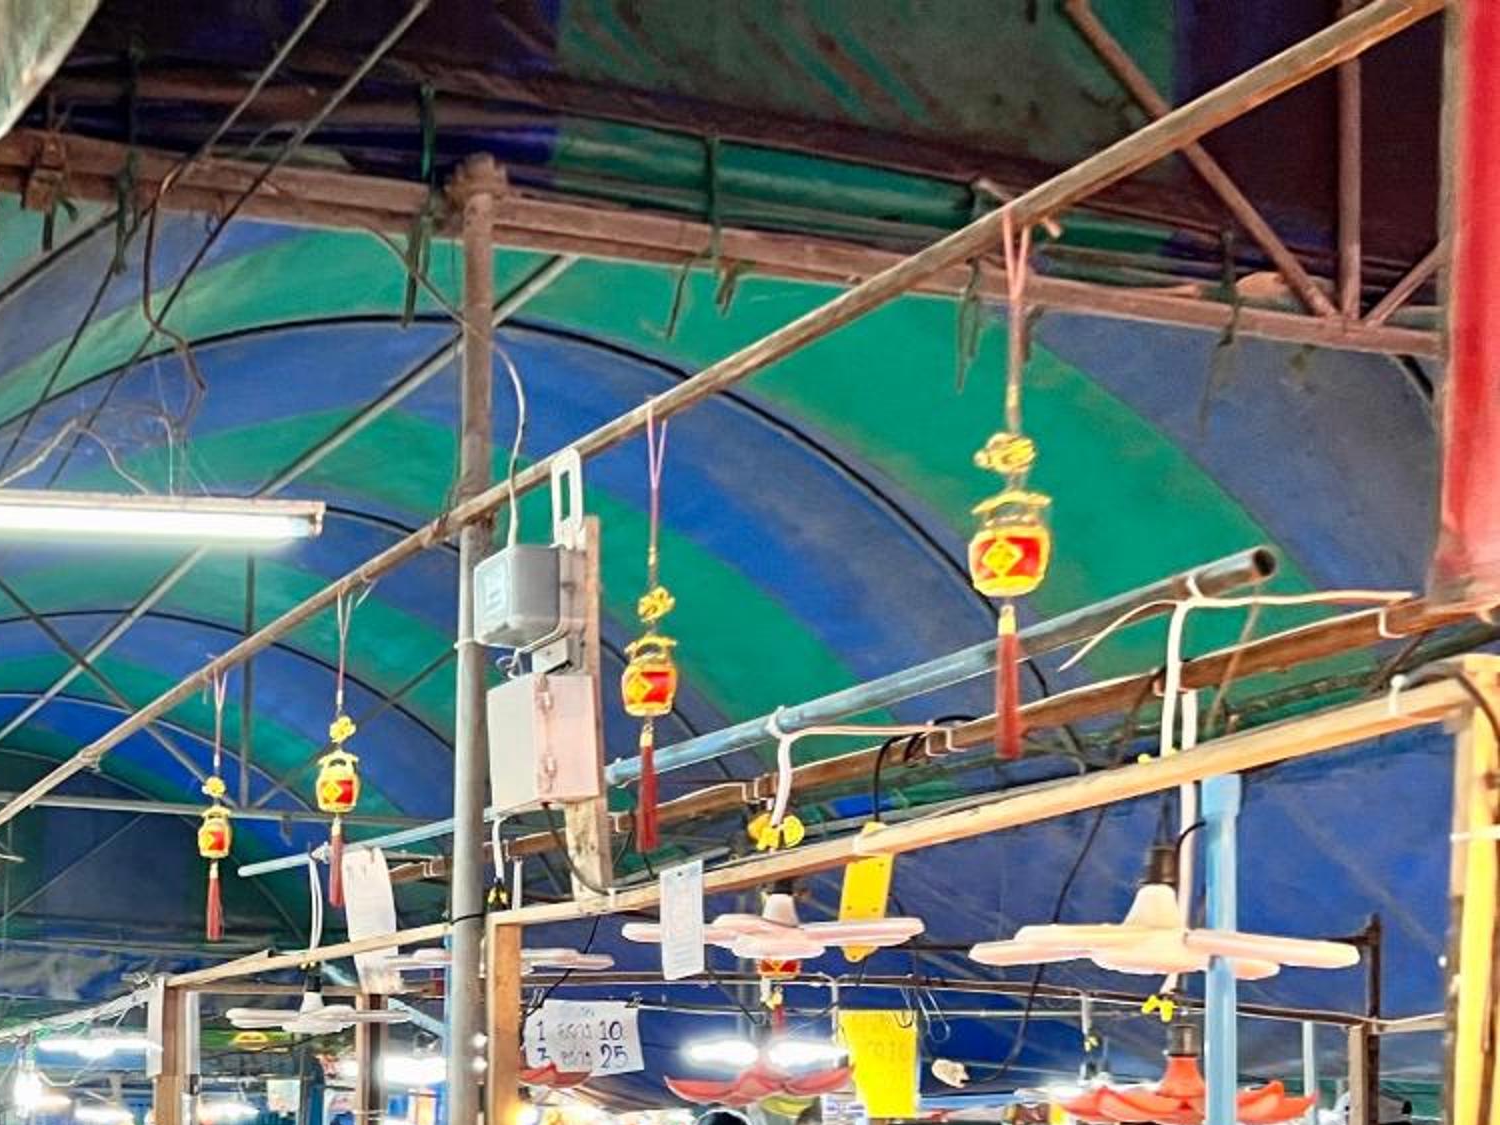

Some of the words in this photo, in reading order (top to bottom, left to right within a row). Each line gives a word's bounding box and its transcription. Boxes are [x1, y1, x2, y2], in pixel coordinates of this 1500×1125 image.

[536, 1020, 546, 1041] 1
[599, 1020, 623, 1041] 10
[600, 1043, 629, 1069] 25
